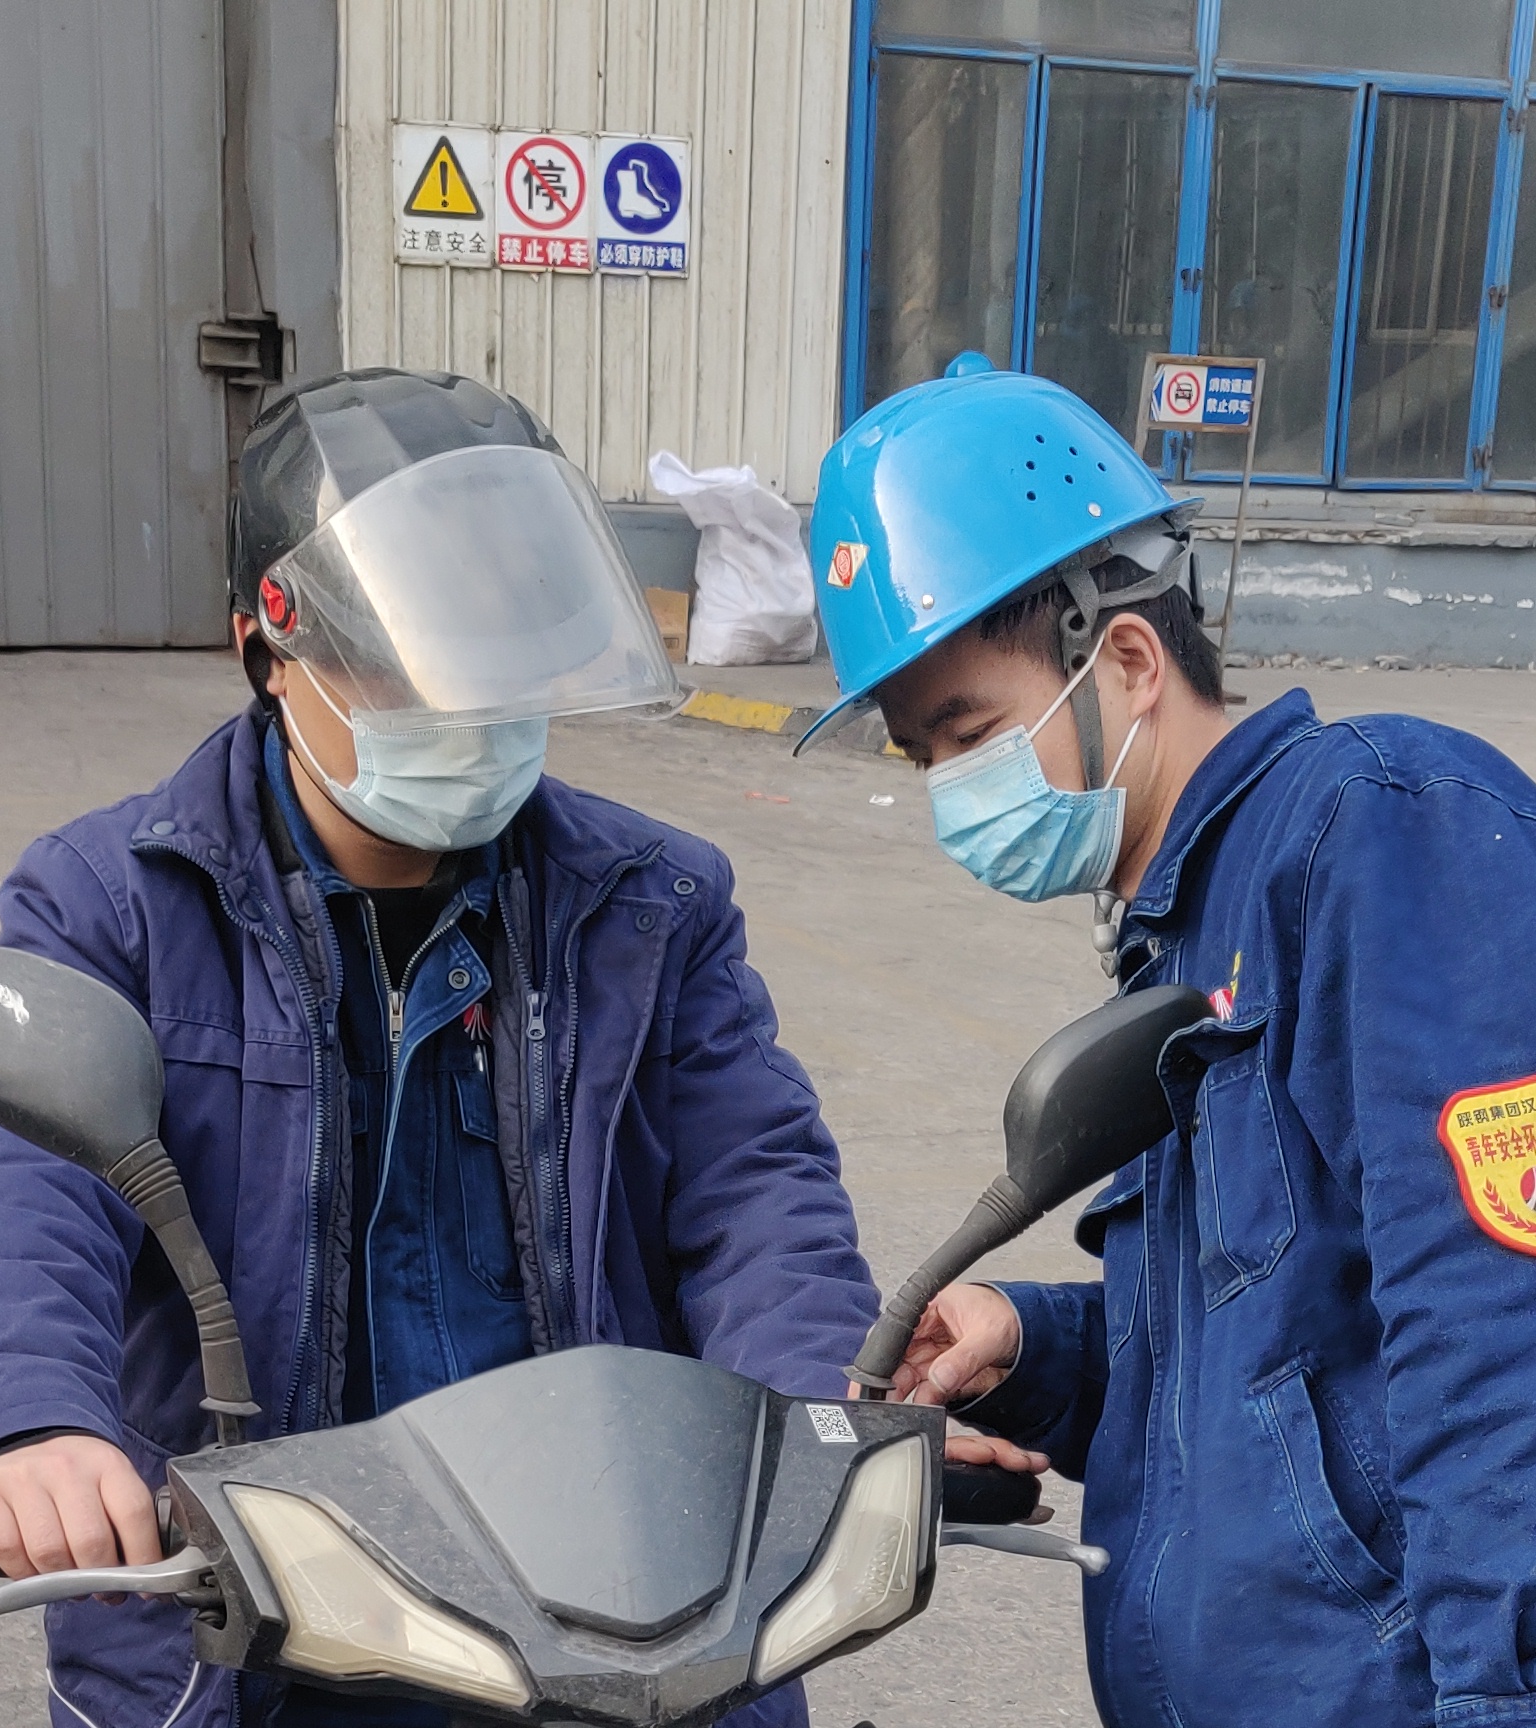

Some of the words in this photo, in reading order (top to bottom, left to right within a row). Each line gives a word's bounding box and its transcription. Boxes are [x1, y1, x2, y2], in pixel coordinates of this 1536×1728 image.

[401, 228, 487, 254] 注意安全
[501, 238, 590, 267] 禁止停车
[599, 242, 684, 269] 必须穿防护鞋
[1205, 397, 1251, 415] 禁止停车
